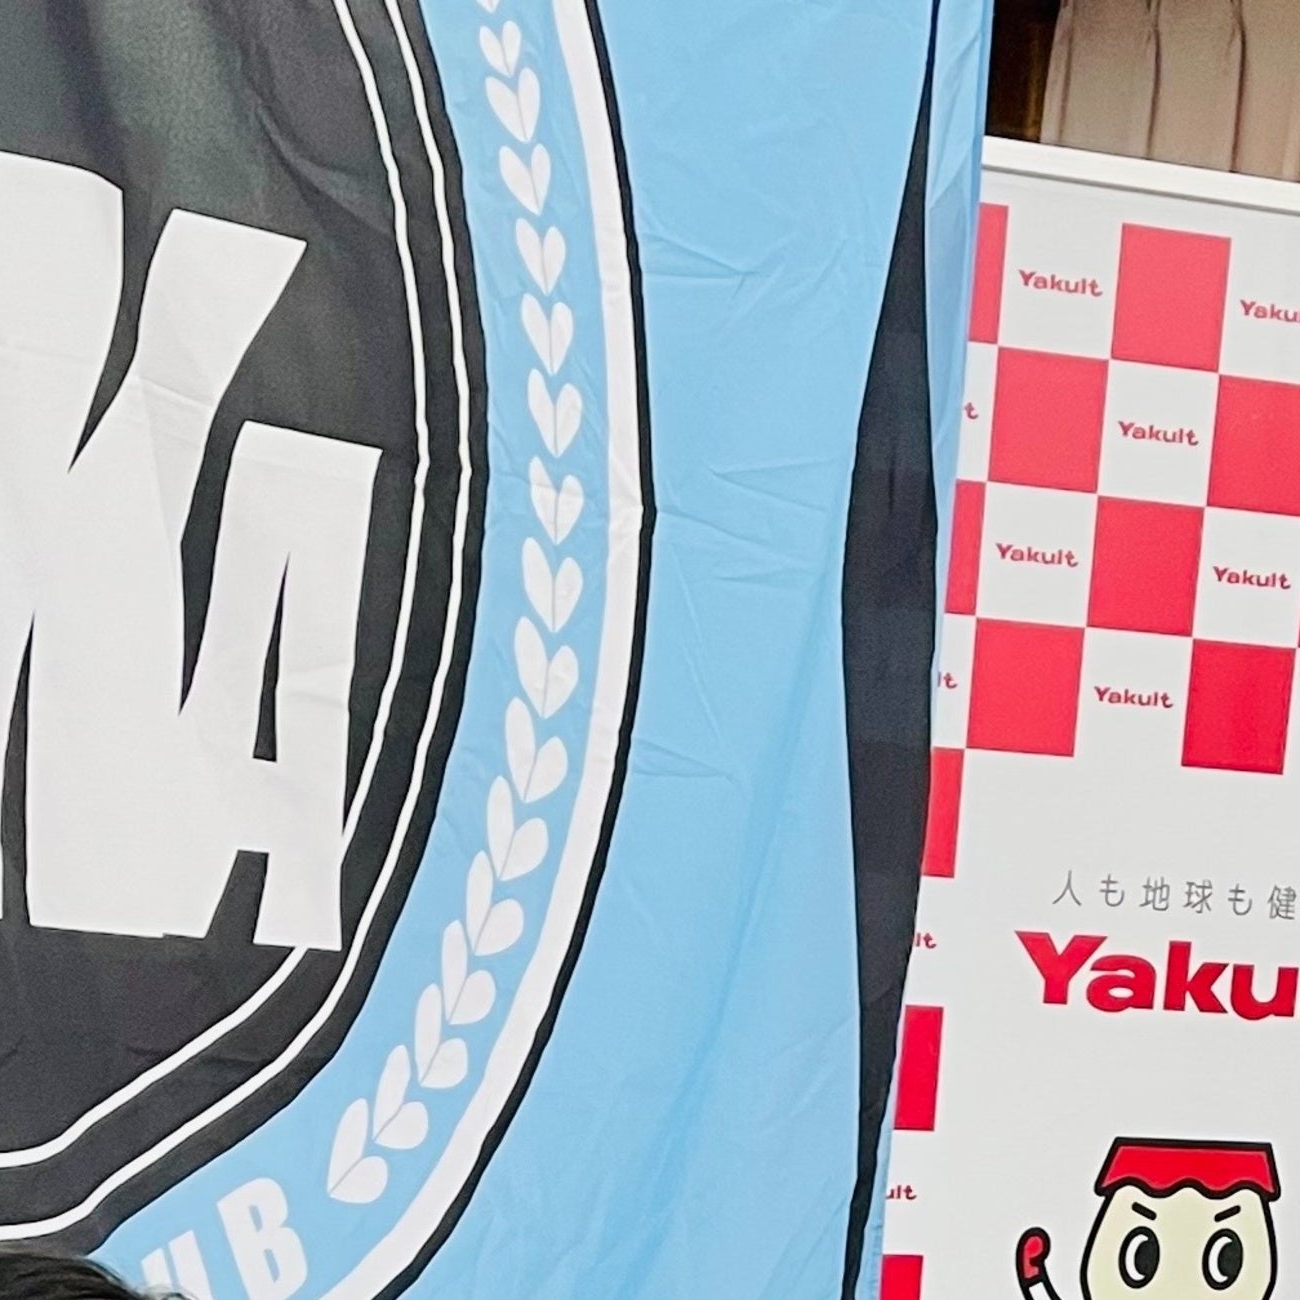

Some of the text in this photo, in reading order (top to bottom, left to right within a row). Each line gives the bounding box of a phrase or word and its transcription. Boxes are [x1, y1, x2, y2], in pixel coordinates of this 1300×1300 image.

[1020, 270, 1102, 296] Yakult
[1118, 421, 1198, 445] Yakult
[996, 543, 1078, 567] Yakult
[1213, 567, 1291, 590] Yakult
[1094, 686, 1173, 708] Yakult
